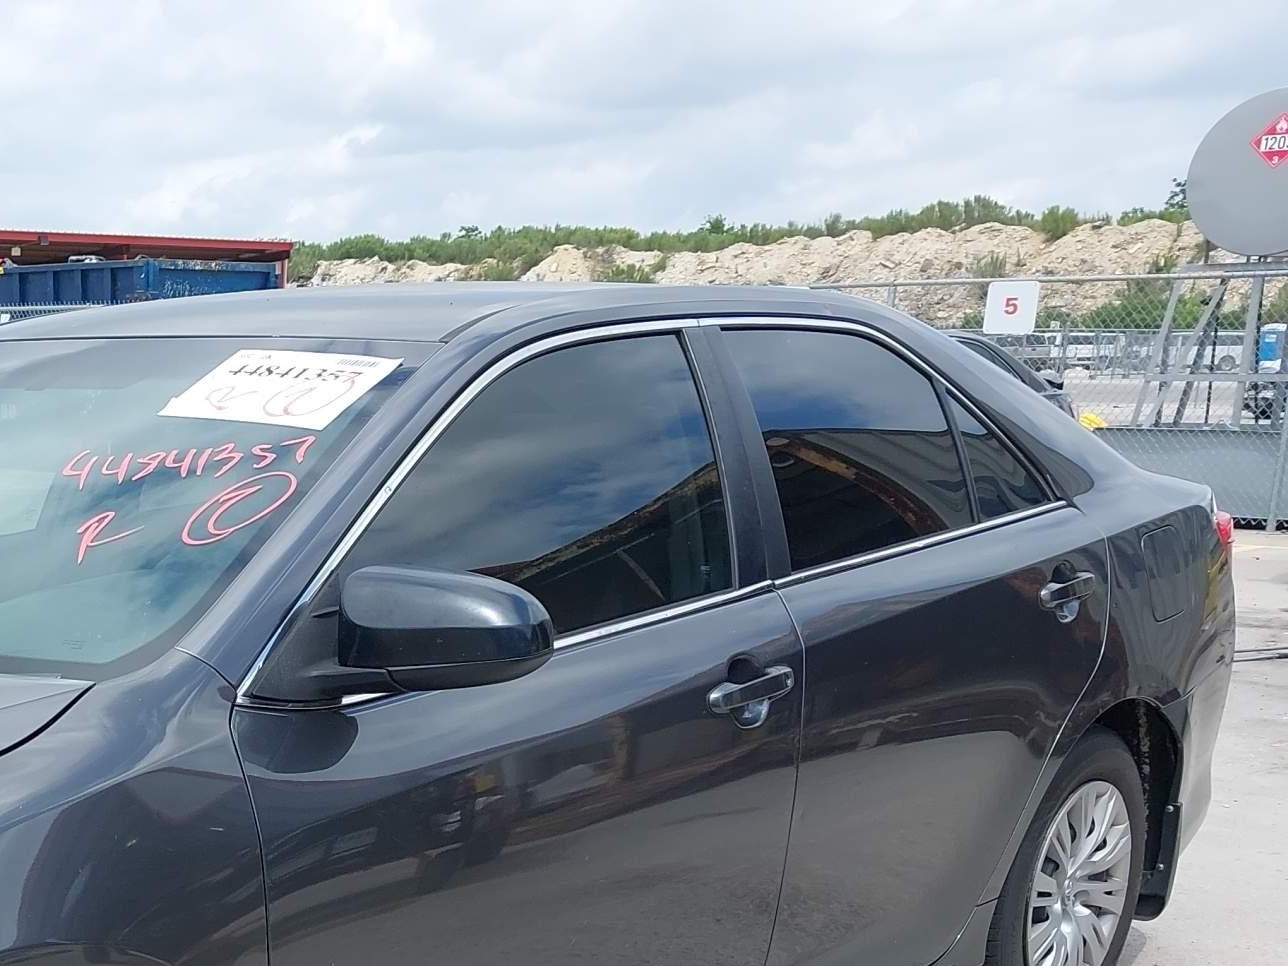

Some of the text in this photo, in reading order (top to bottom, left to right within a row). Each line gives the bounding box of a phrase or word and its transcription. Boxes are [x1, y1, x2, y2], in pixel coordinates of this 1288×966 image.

[1264, 135, 1288, 150] 120
[1271, 155, 1280, 164] 3
[1003, 297, 1019, 316] 5
[227, 363, 364, 382] 44841357
[62, 434, 317, 491] 44841357
